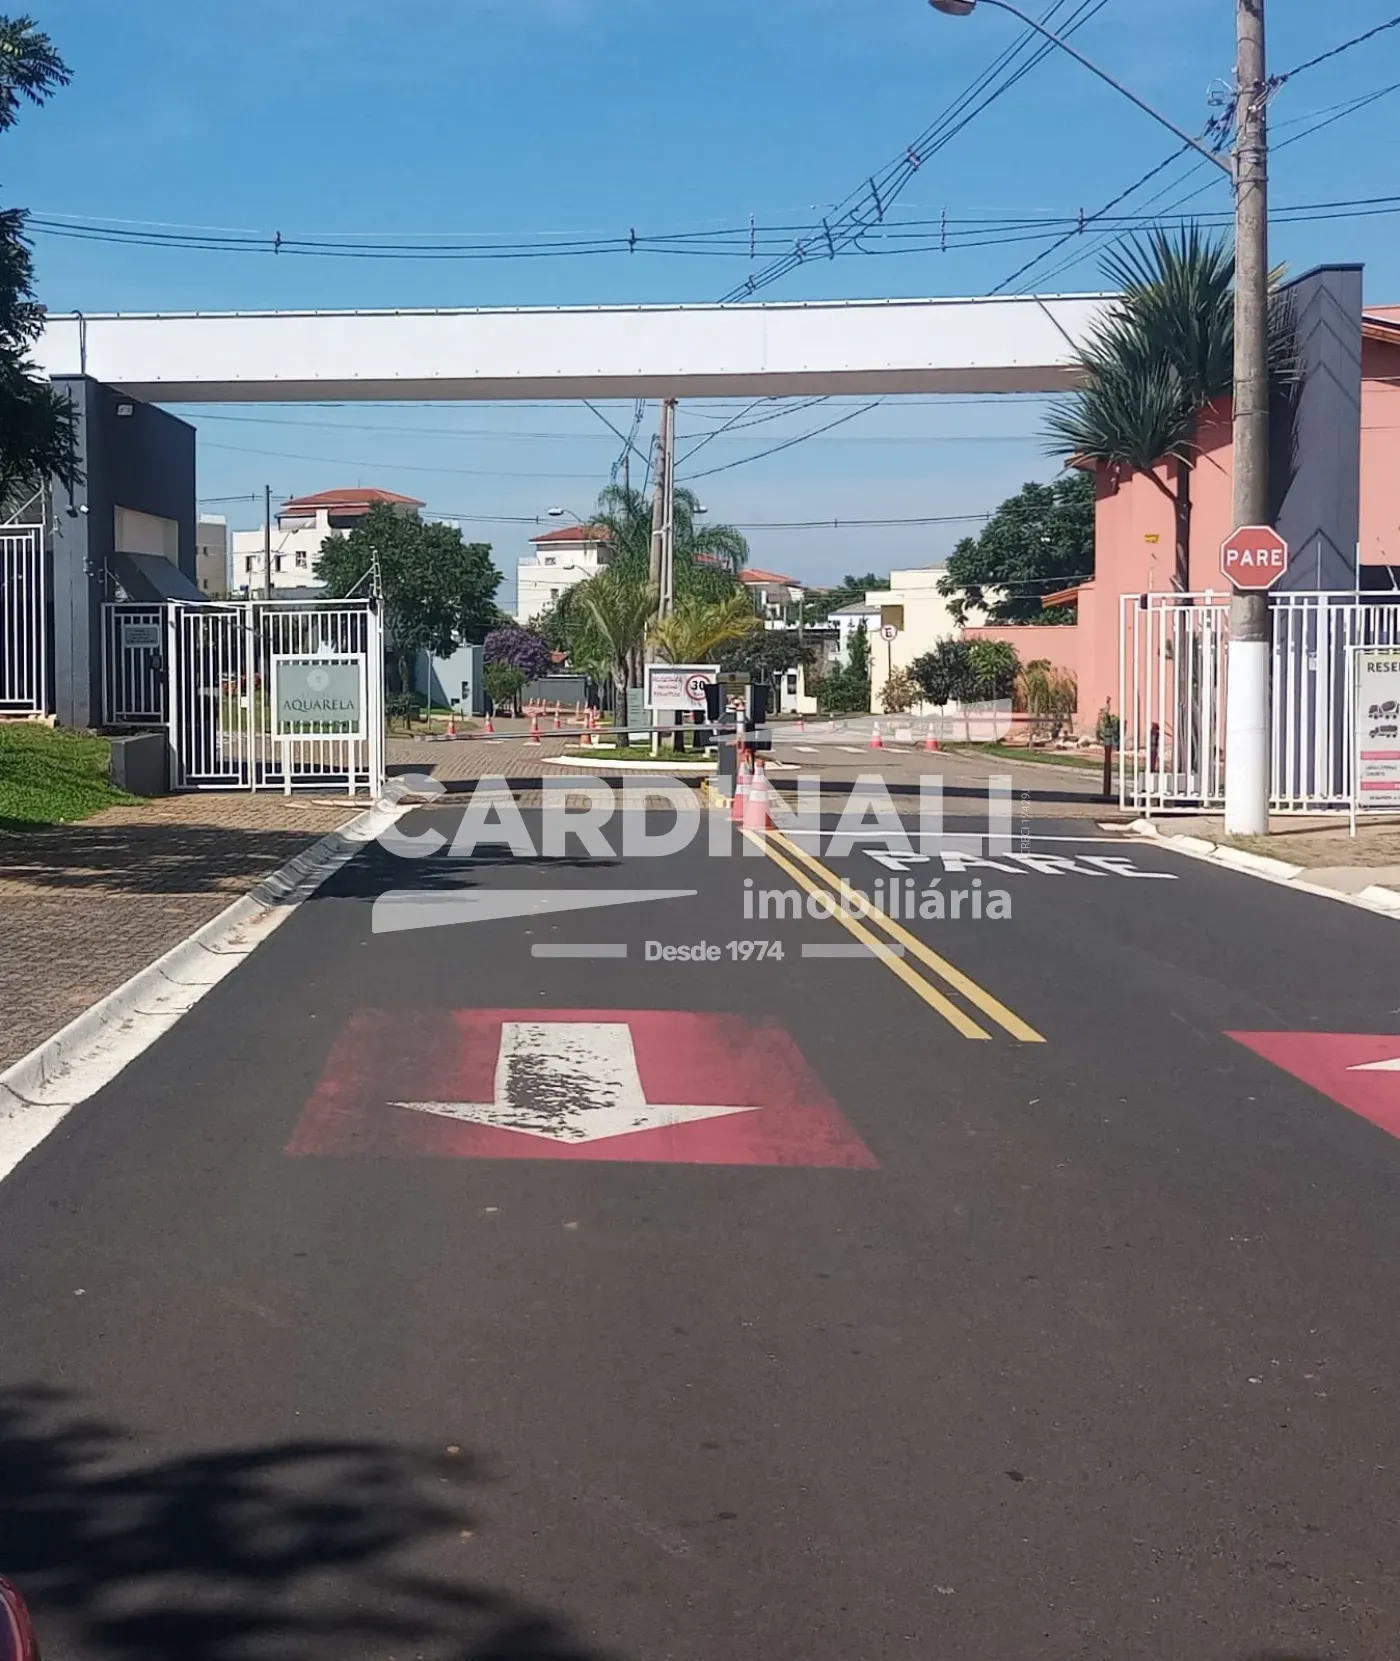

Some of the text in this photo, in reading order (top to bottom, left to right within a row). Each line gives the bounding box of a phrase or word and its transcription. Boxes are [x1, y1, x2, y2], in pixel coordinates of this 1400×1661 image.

[1226, 548, 1283, 567] PARE
[690, 680, 705, 691] 30
[283, 698, 355, 713] AQUARELA
[862, 849, 1179, 879] PARE
